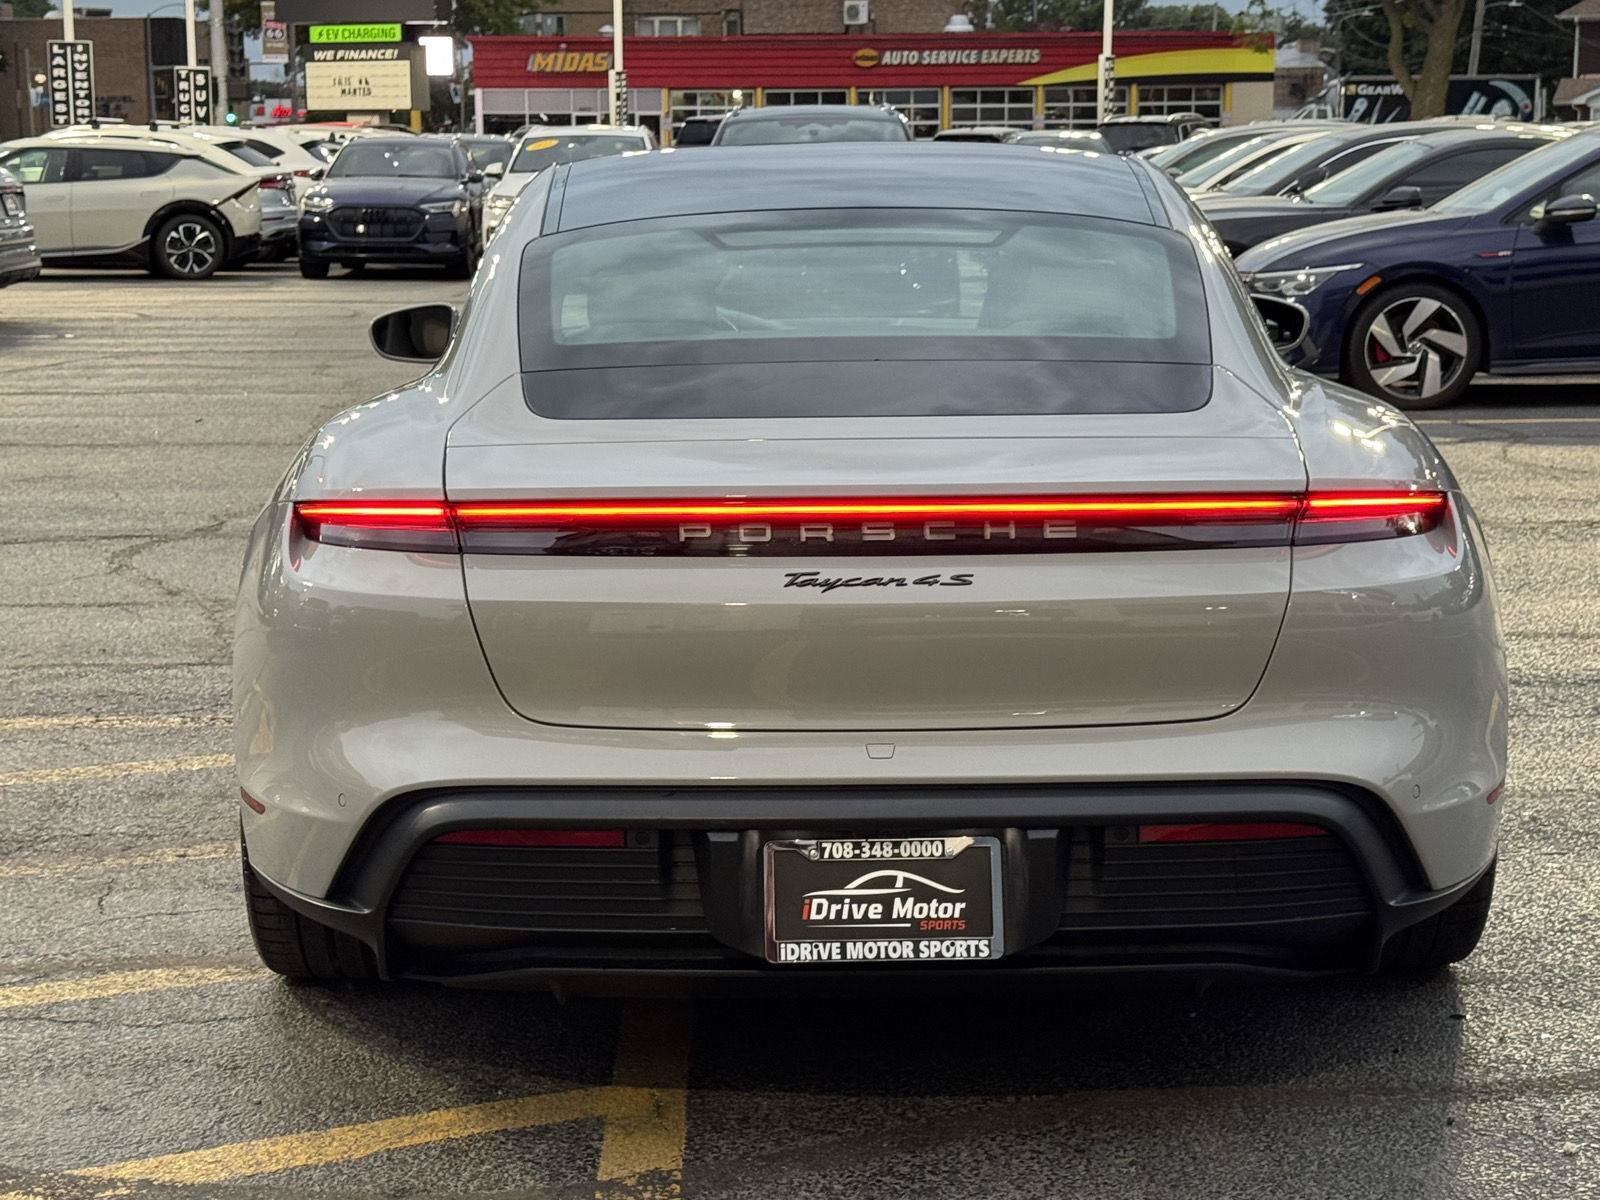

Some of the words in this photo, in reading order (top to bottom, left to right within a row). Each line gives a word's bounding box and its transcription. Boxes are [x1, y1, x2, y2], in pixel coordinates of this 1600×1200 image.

[326, 28, 340, 40] EV
[341, 27, 396, 39] CHARGING
[314, 50, 335, 60] WE
[336, 49, 399, 60] FINANCE!
[529, 51, 610, 72] MIDAS
[881, 50, 919, 65] AUTO
[921, 49, 978, 64] SERVICE
[980, 48, 1040, 64] EXPERTS
[52, 44, 68, 124] LARGEST
[73, 44, 90, 124] INVENTORY
[195, 73, 207, 118] SUV
[679, 520, 1077, 542] PORSCHE
[783, 571, 908, 593] Taycan
[912, 574, 974, 587] 4S
[821, 840, 942, 859] 708-348-0000
[802, 897, 883, 920] iDrive
[892, 897, 966, 919] Motor
[919, 920, 966, 931] SPORTS
[780, 942, 842, 961] iDRIVE
[846, 941, 915, 960] MOTOR
[919, 940, 990, 958] SPORTS
